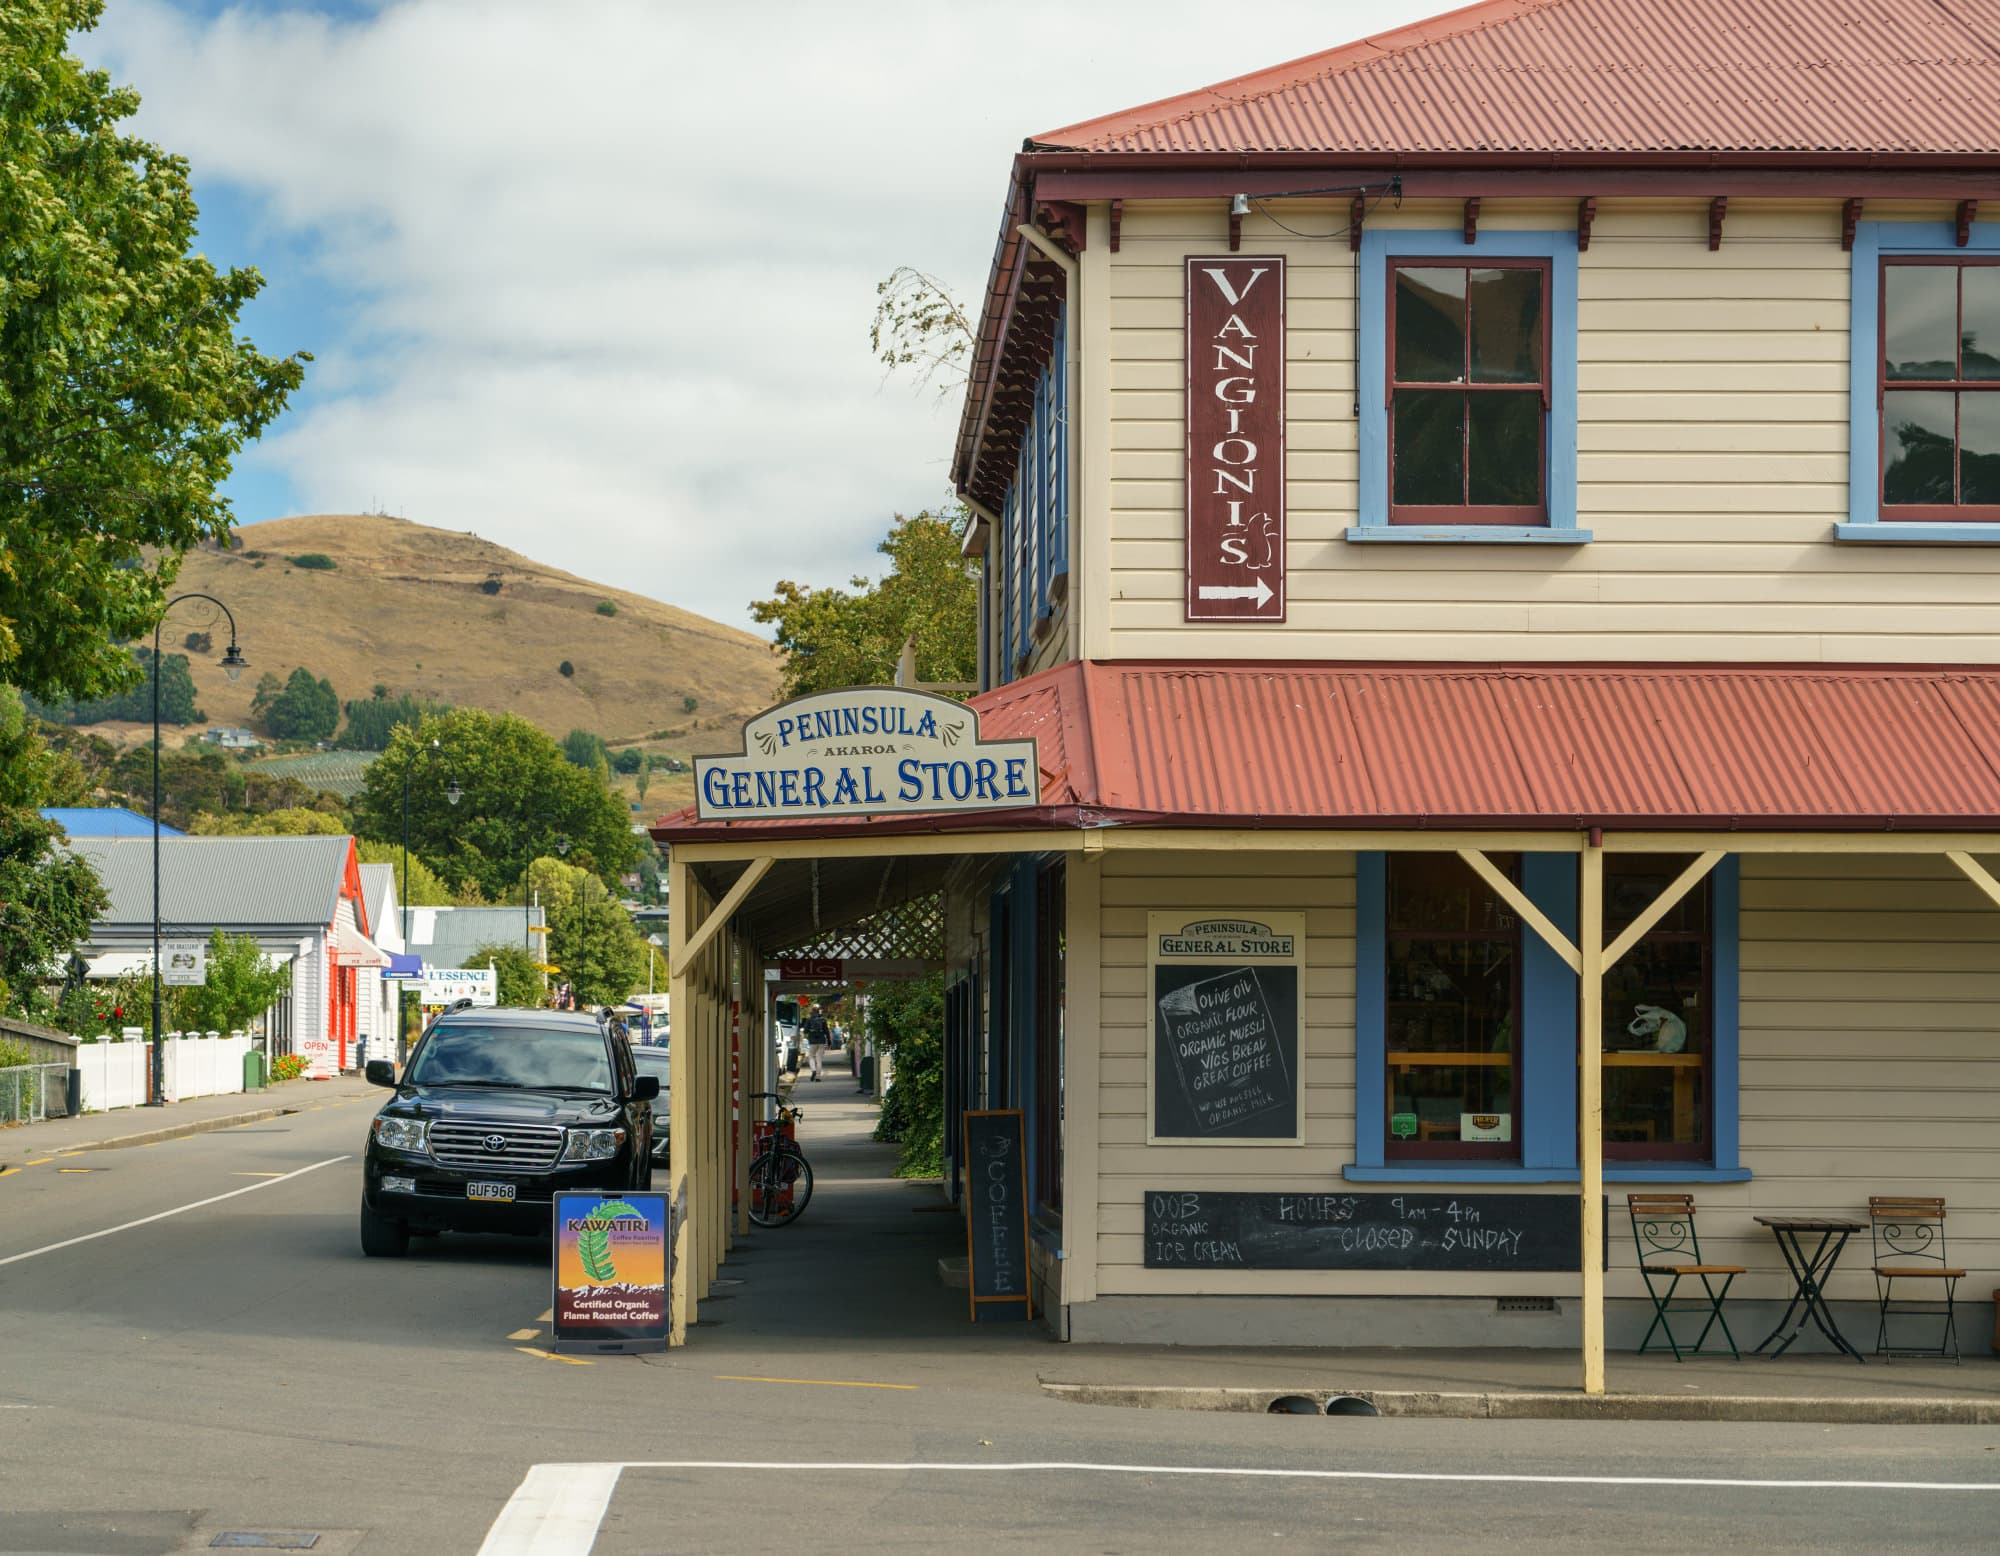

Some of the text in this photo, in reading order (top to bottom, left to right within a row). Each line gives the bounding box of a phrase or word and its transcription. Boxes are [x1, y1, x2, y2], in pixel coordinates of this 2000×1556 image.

[1202, 268, 1269, 565] VANGIONIS
[777, 705, 939, 747] PENINSULA
[823, 744, 897, 757] AKAROA
[703, 758, 1031, 809] GENERAL STORE
[1195, 923, 1257, 935] PENINSULA
[1162, 938, 1290, 954] GENERAL STORE
[429, 971, 488, 981] L'ESSENCE
[1226, 1001, 1258, 1023] FLOUR
[304, 1041, 329, 1051] OPEN
[1180, 1031, 1226, 1057] ORGANIC
[1232, 1038, 1267, 1061] BREAD
[1193, 1053, 1272, 1090] GREAT COFFEE
[468, 1184, 514, 1198] GUF968
[1152, 1194, 1201, 1218] OOB
[1279, 1197, 1354, 1220] HOURS
[567, 1219, 649, 1232] KAWATIRI
[988, 1160, 1013, 1293] COFFEE
[1151, 1222, 1209, 1237] ORGANIC
[1193, 1241, 1243, 1262] CREAM
[1441, 1227, 1522, 1256] SUNDAY
[563, 1311, 660, 1320] Flame Roasted Coffee
[573, 1300, 649, 1311] Certified Organic
